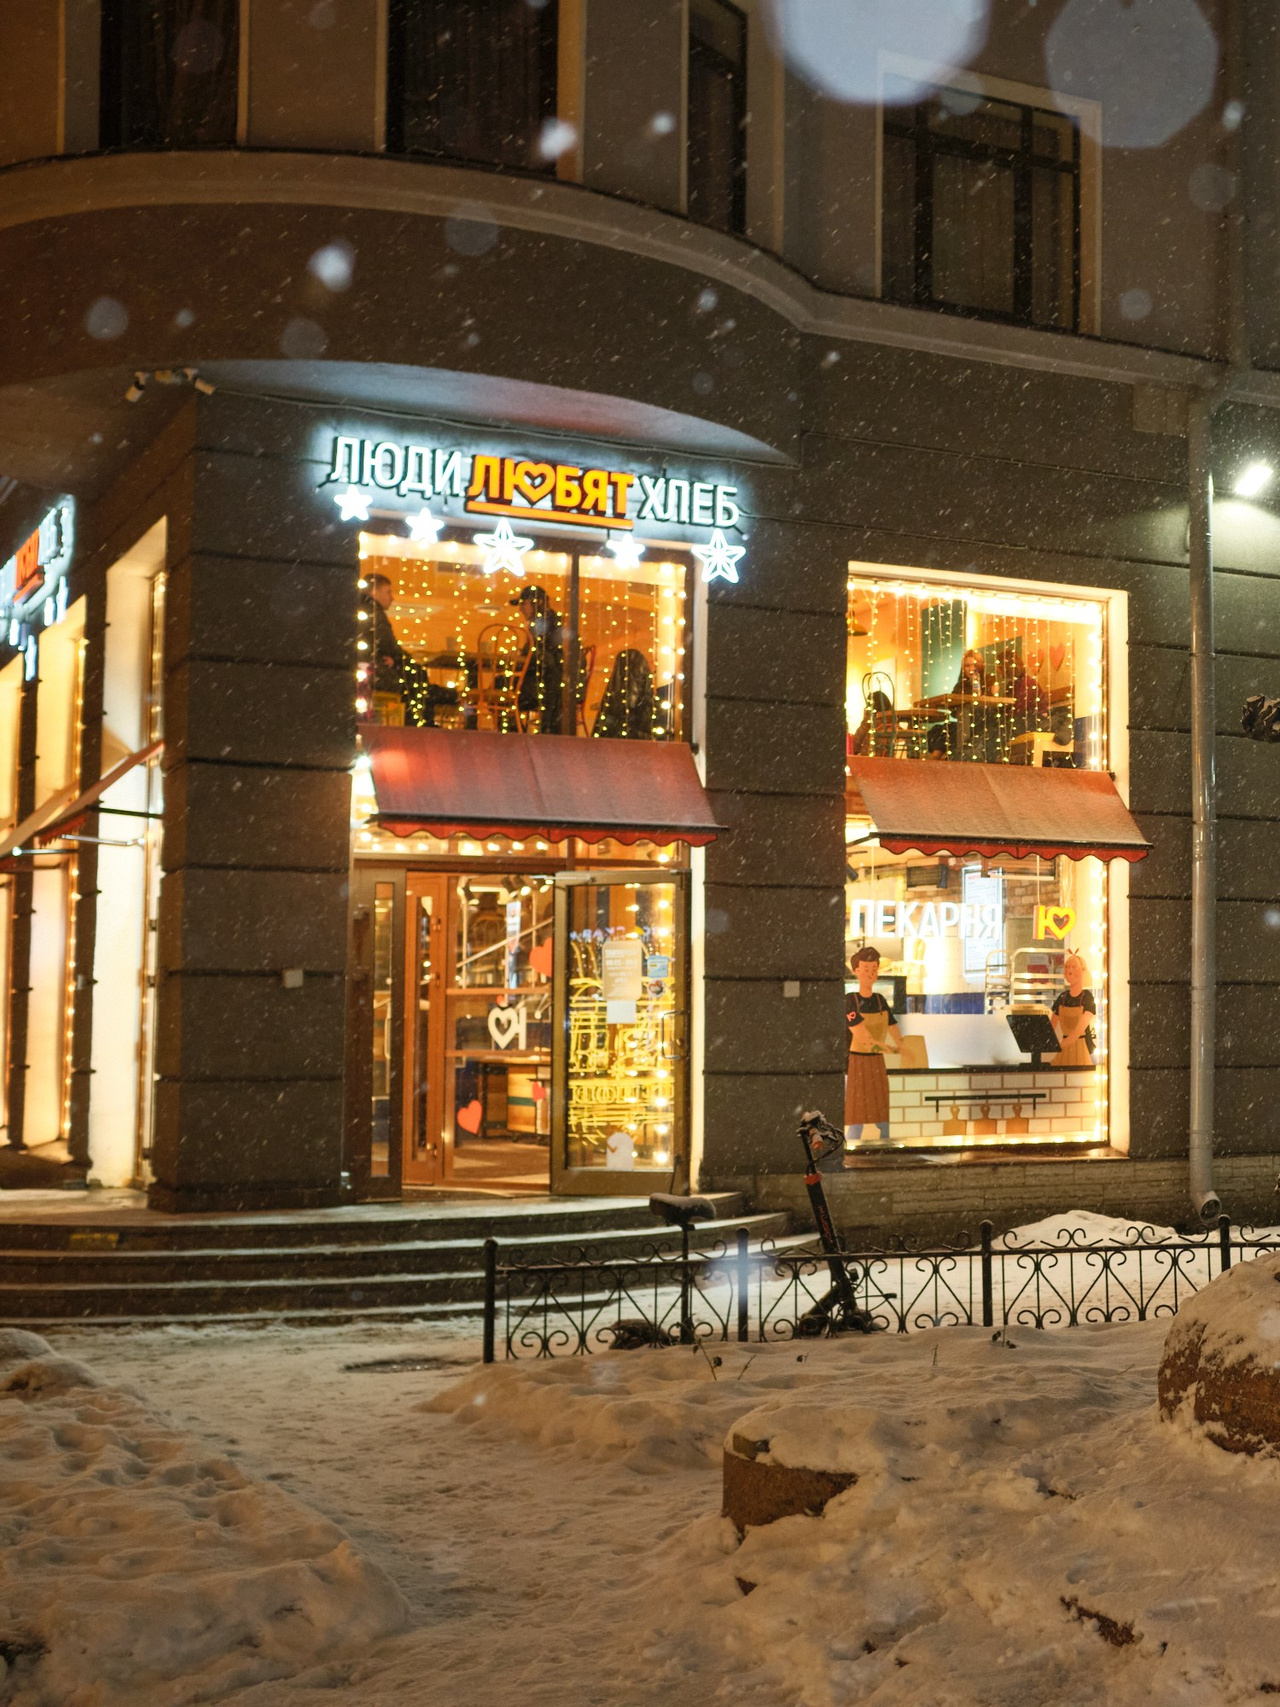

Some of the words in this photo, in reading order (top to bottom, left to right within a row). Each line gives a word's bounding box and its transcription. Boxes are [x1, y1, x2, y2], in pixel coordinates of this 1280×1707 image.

[330, 436, 463, 498] ЛЮДИ
[465, 454, 635, 516] ЛЮБЯТ
[639, 474, 739, 528] ХЛЕБ
[851, 899, 1001, 940] ПЕКАРНЯ
